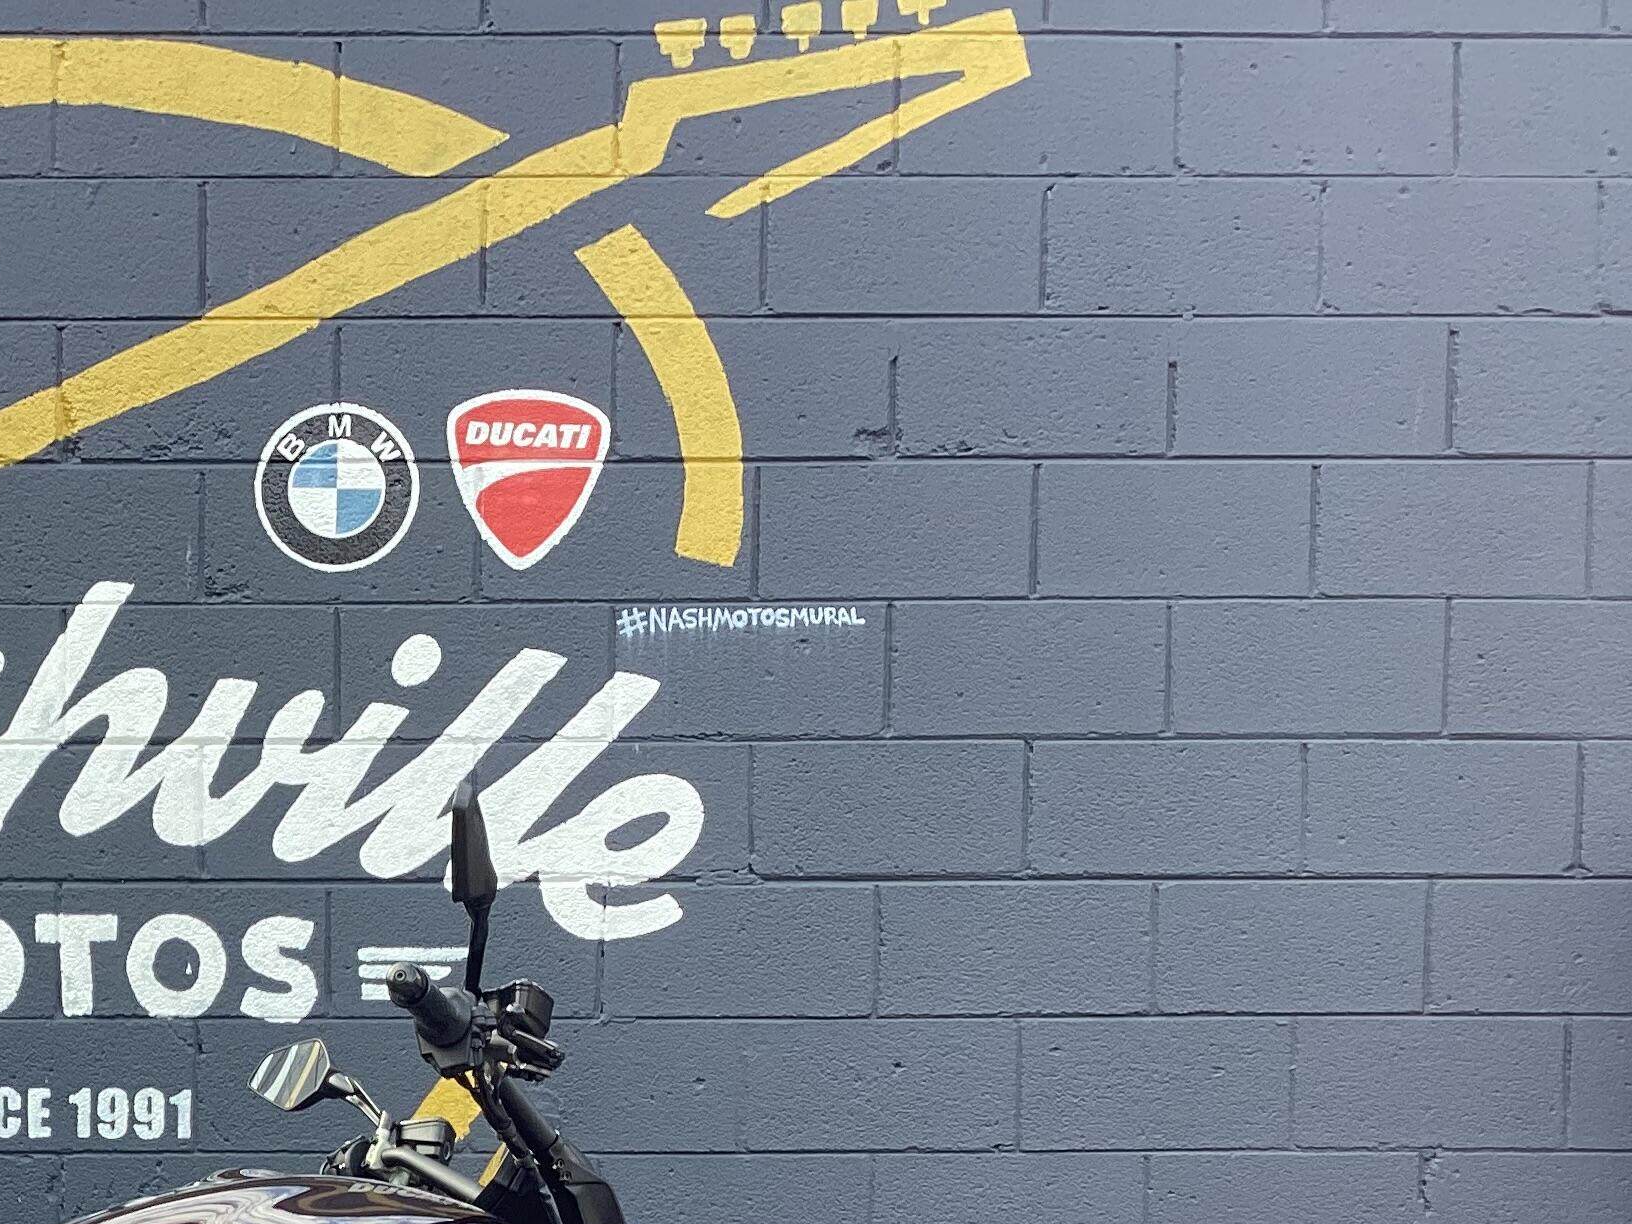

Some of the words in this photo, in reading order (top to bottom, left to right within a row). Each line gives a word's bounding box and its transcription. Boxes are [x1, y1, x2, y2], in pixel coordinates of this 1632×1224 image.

[276, 414, 402, 462] BMW
[465, 420, 593, 450] DUCATI
[616, 606, 866, 638] #NASHMOTOSMURAL
[68, 1086, 193, 1140] 1991
